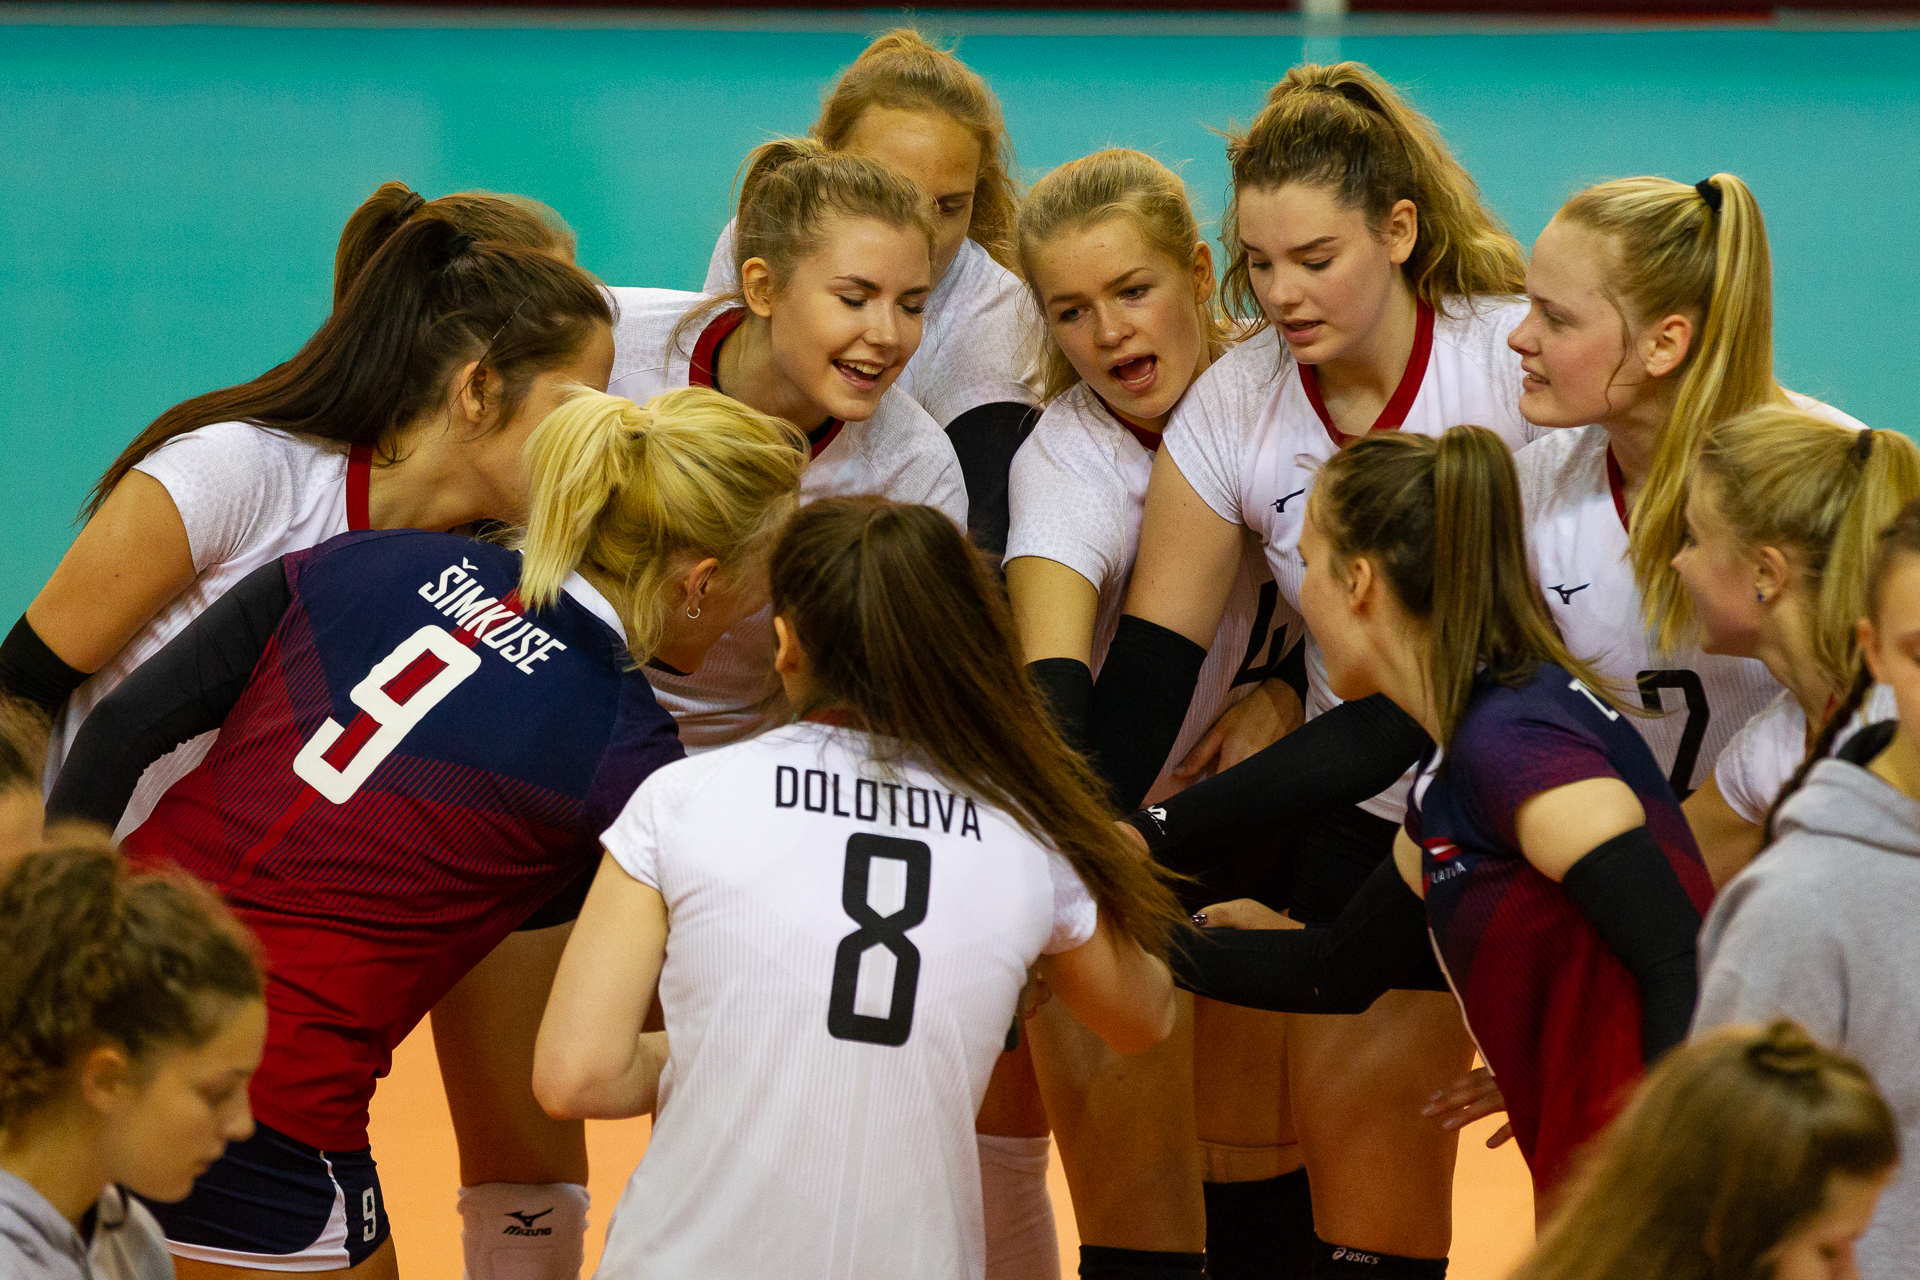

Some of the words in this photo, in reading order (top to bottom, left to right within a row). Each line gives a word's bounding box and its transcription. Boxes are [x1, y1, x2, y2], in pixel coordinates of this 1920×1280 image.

[418, 557, 567, 675] ŠIMKUSE
[293, 624, 481, 804] 9
[775, 765, 982, 841] DOLOTOVA
[827, 832, 931, 1048] 8
[362, 1187, 377, 1242] 9
